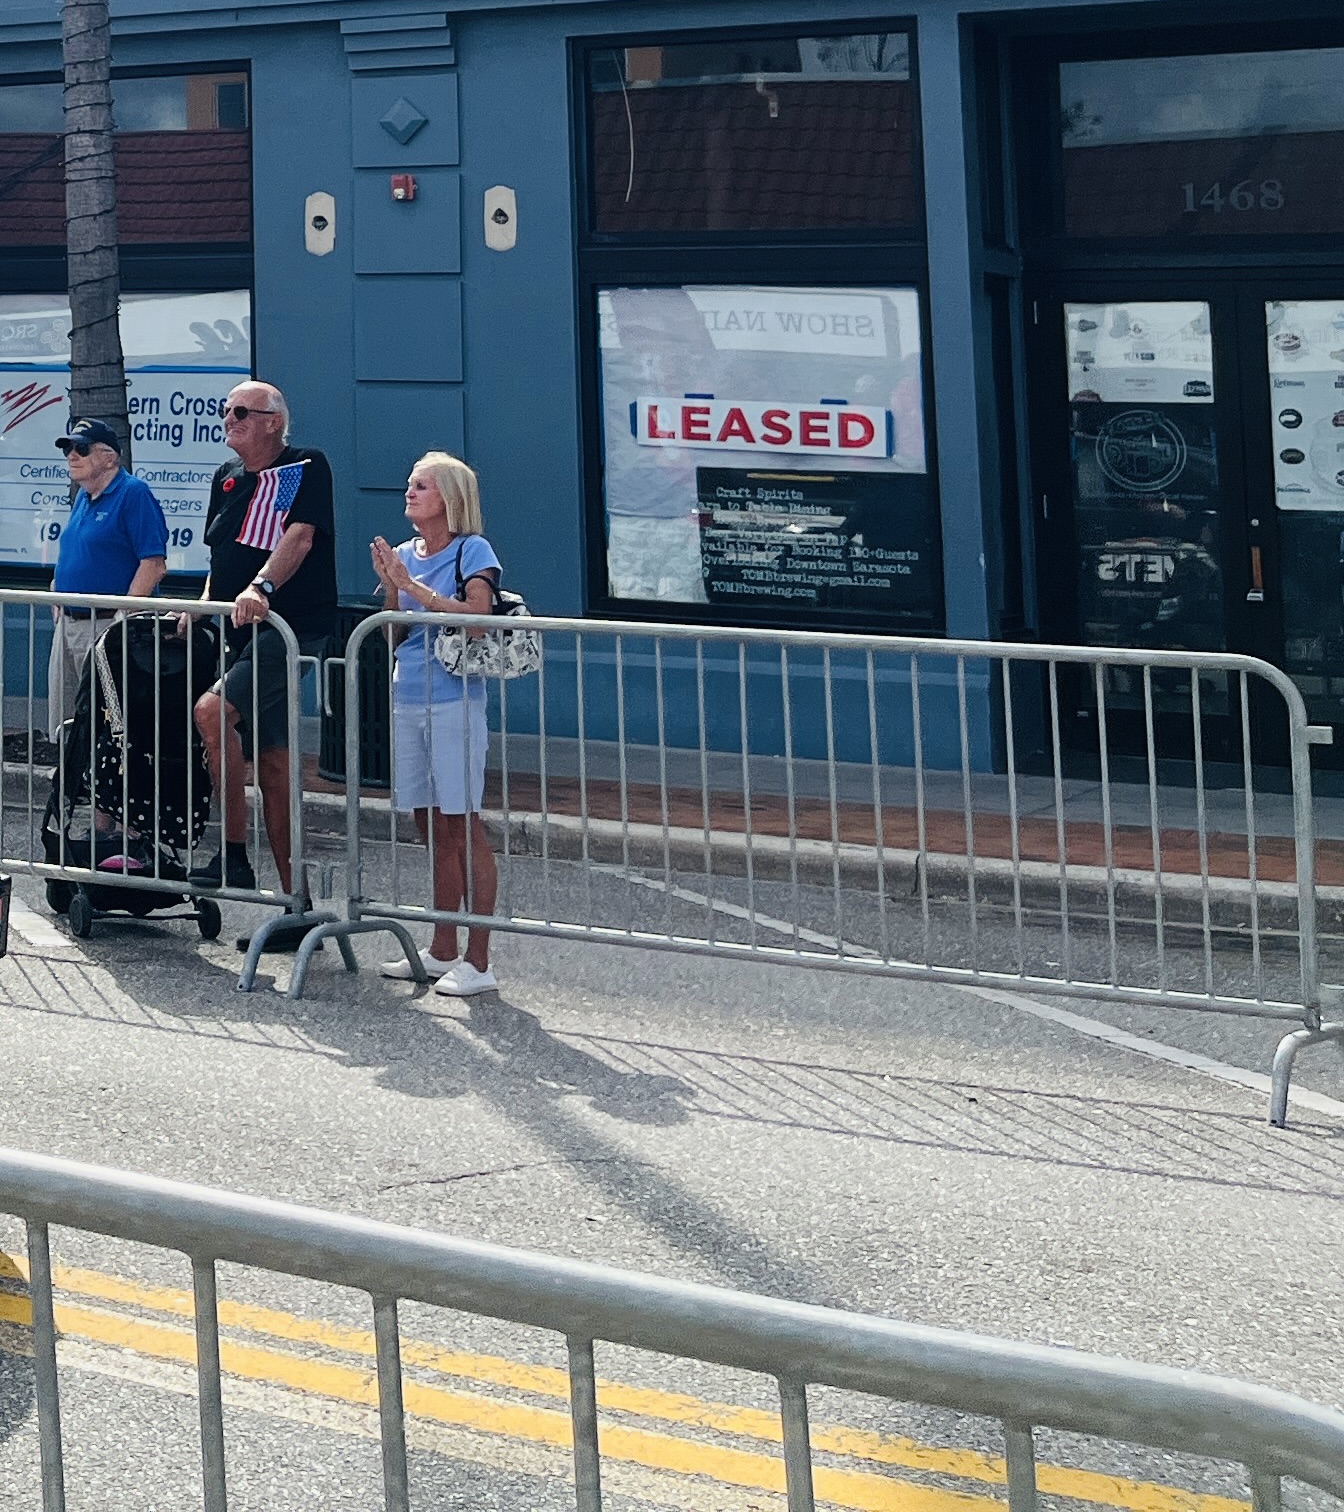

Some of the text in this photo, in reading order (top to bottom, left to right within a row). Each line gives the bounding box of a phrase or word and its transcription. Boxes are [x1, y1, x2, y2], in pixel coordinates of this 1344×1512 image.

[1181, 178, 1285, 214] 1468
[647, 405, 875, 448] LEASED
[135, 468, 212, 483] Contractors
